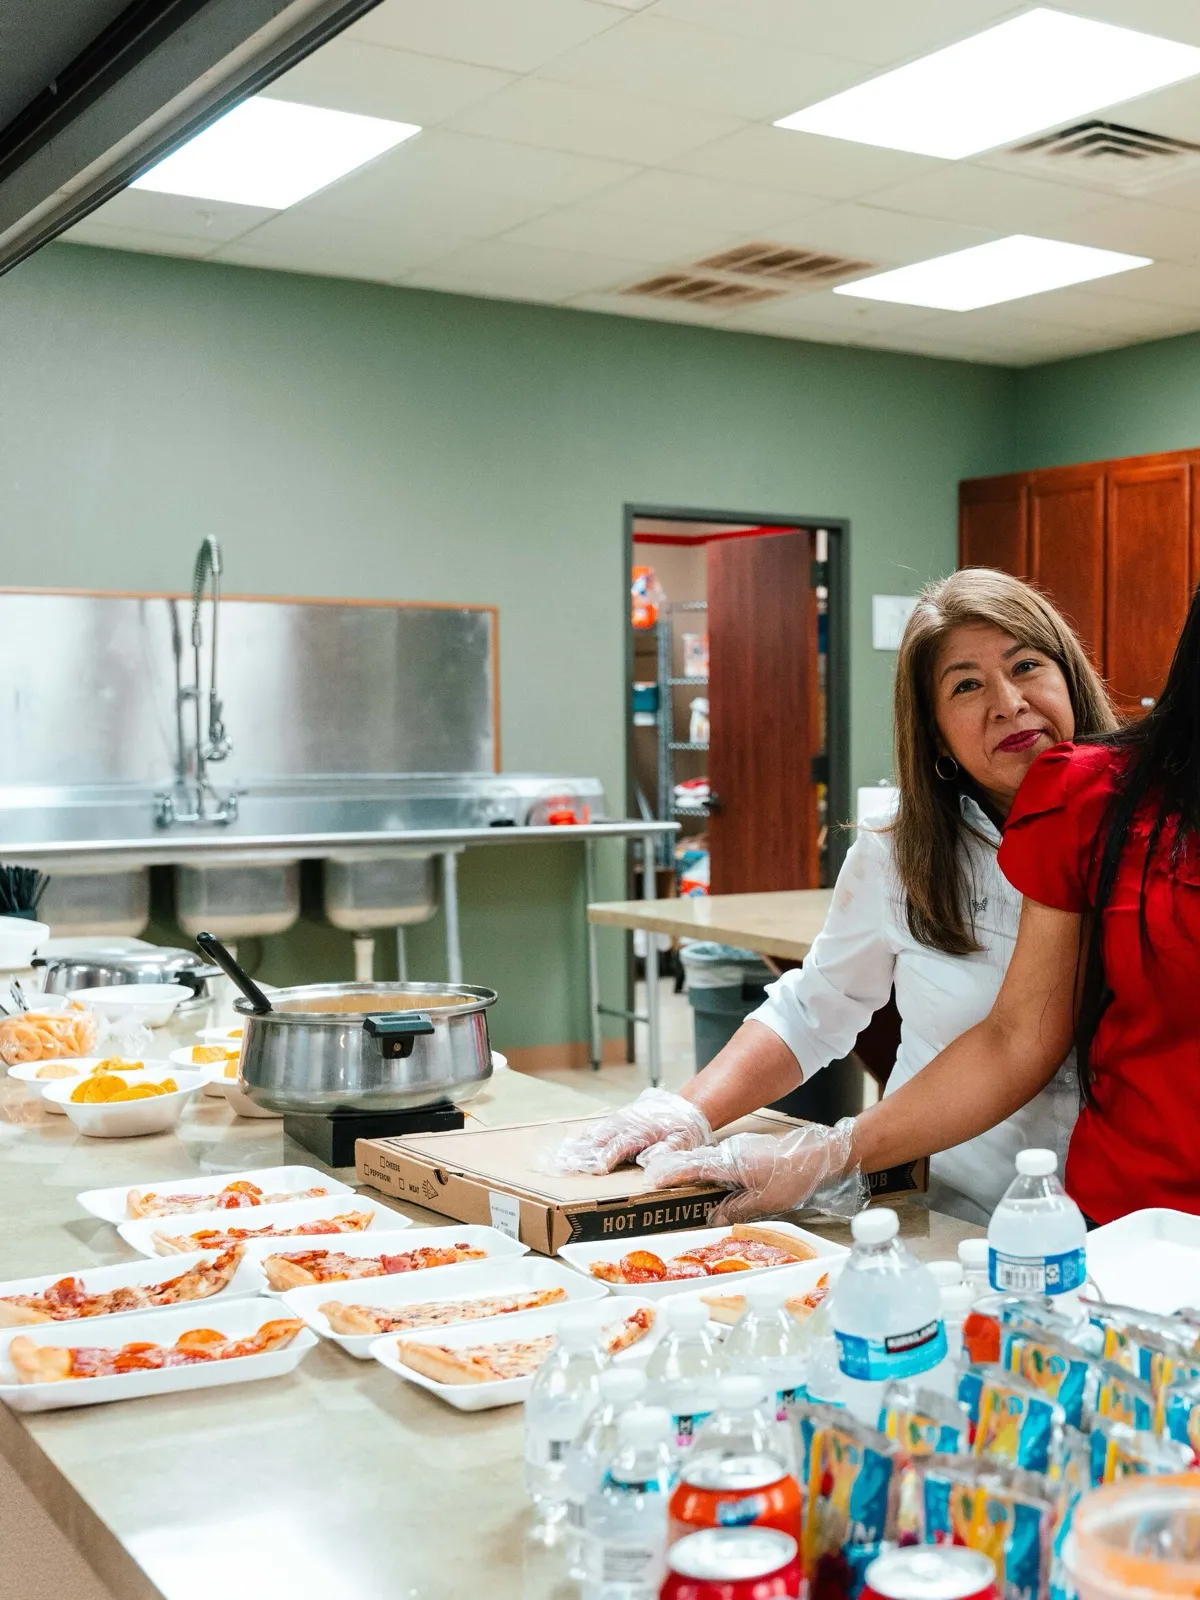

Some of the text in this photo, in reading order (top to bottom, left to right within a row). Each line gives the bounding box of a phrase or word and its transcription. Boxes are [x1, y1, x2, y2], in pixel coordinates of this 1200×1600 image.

[386, 1160, 400, 1172] CHEESE
[370, 1168, 391, 1183] PEPPERONI
[870, 1172, 889, 1188] UB
[409, 1184, 420, 1194] MEAT
[602, 1200, 719, 1233] HOT DELIVER
